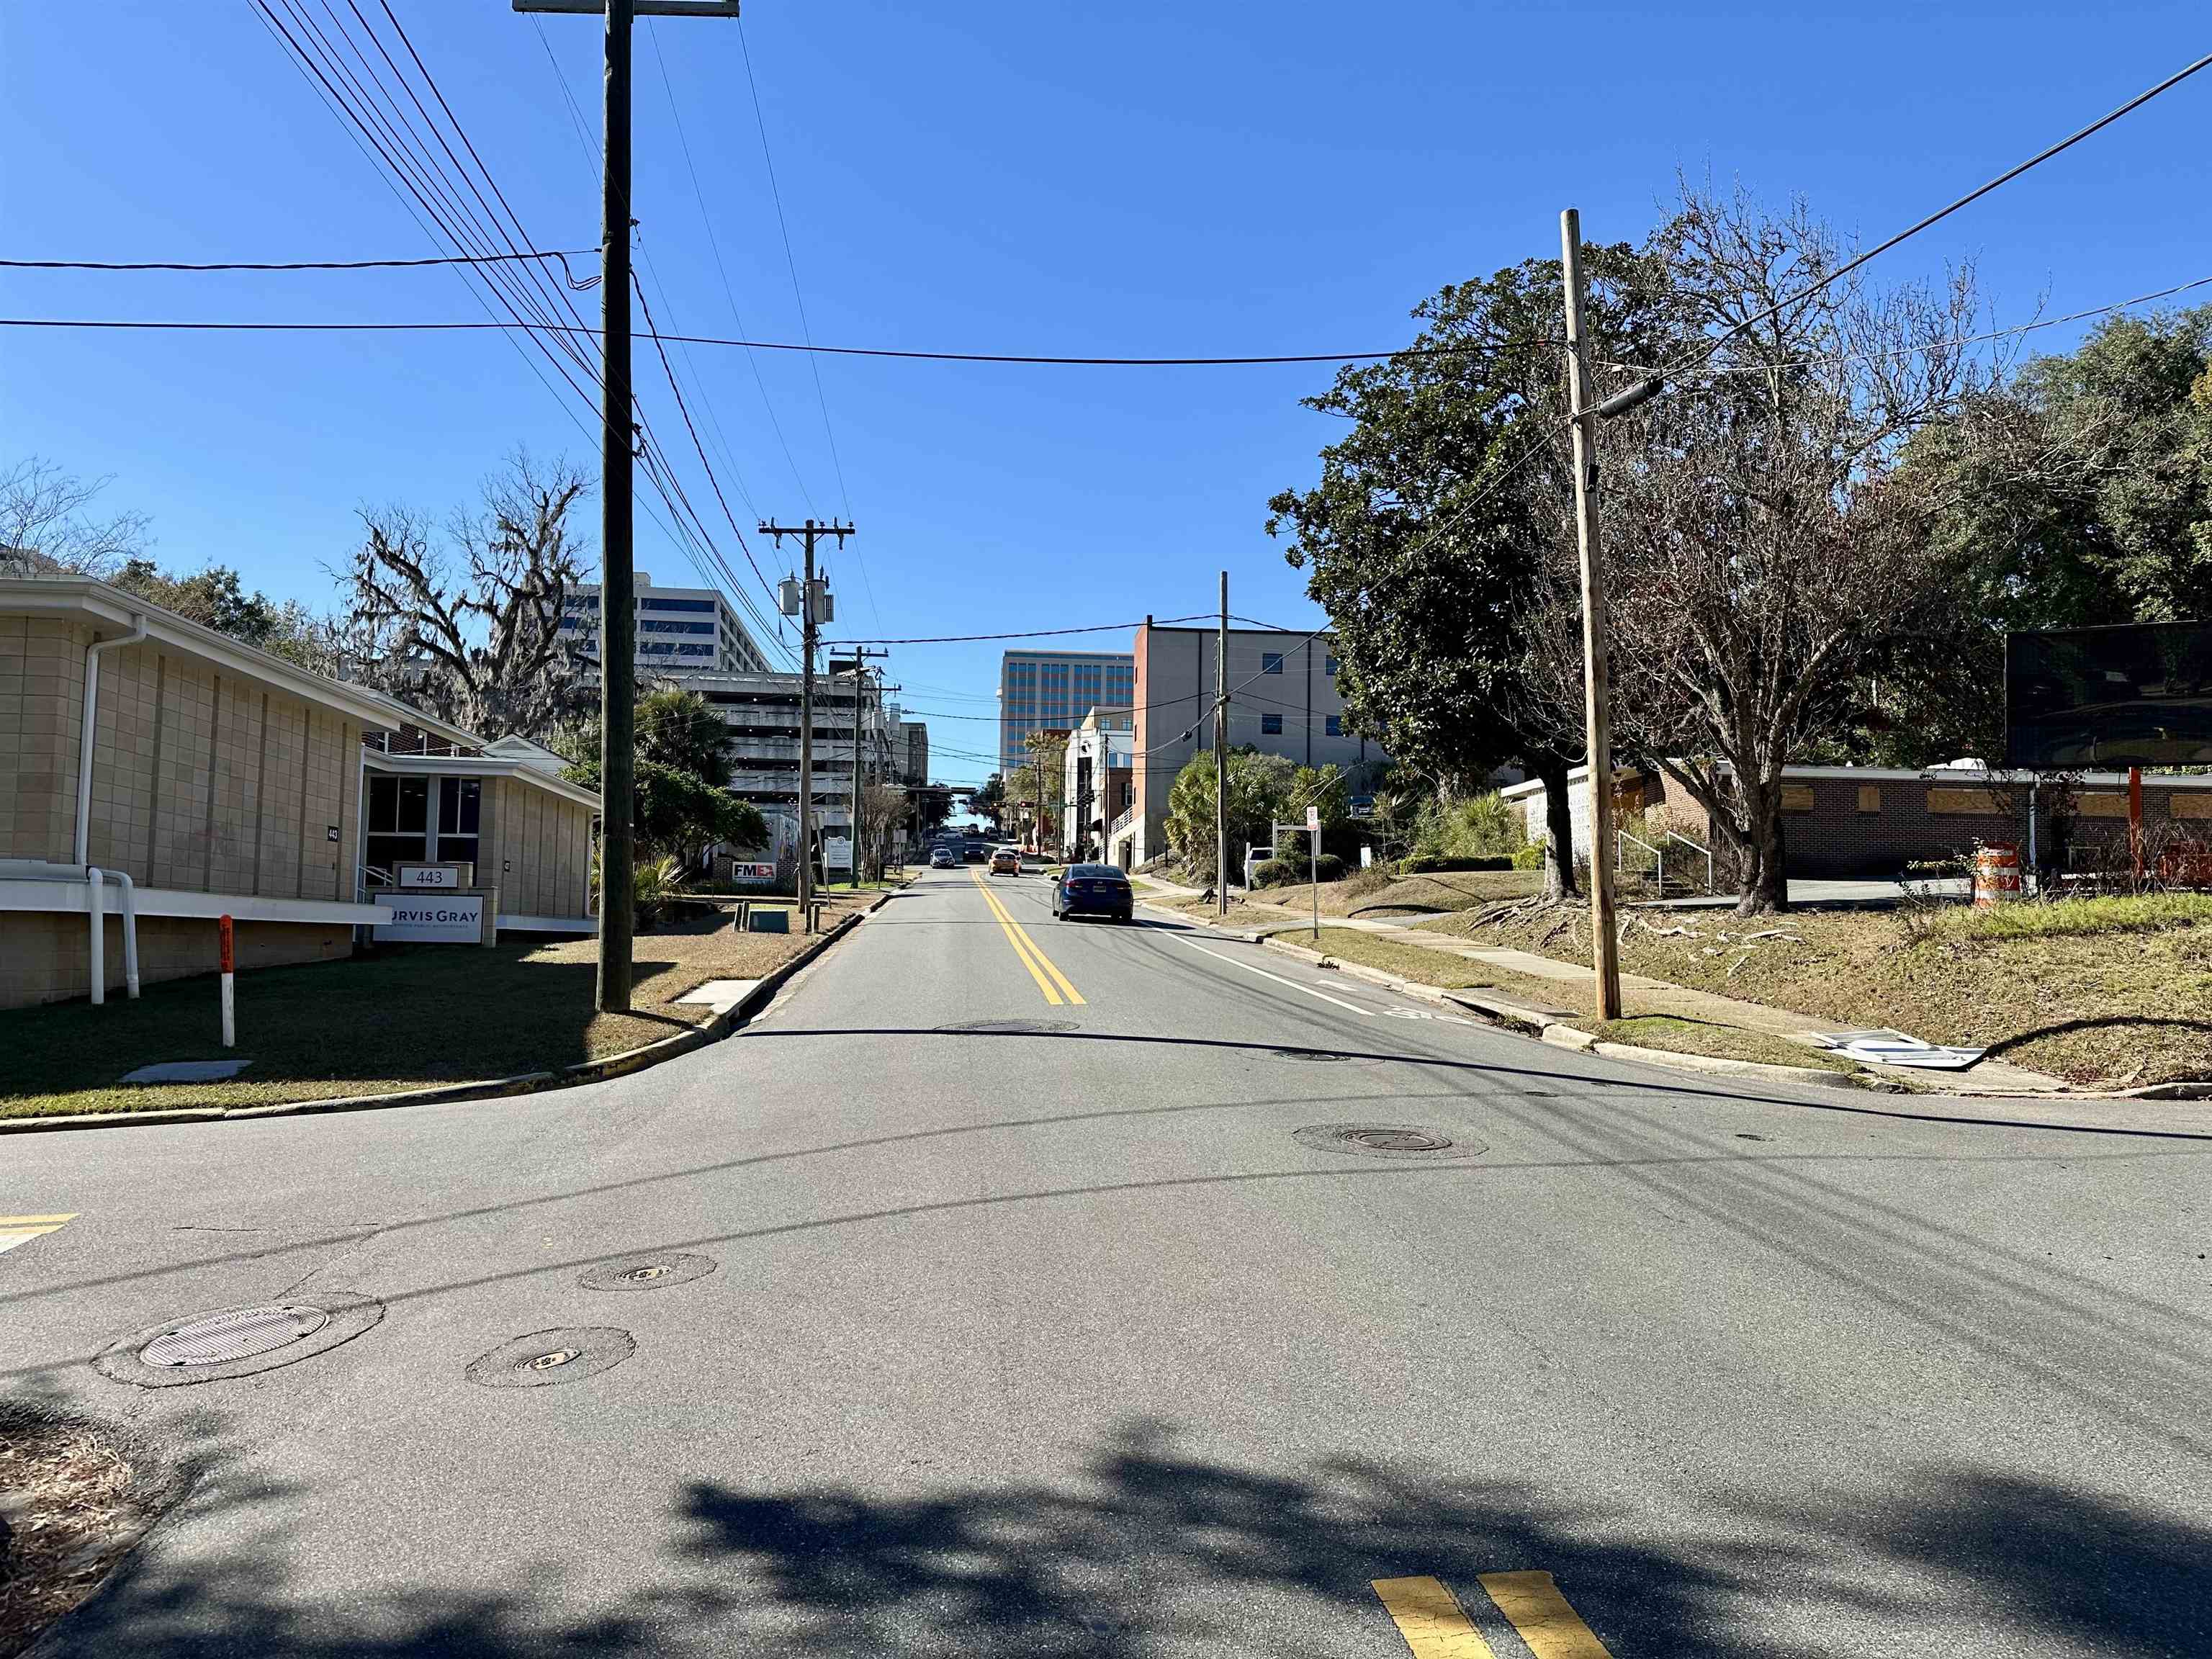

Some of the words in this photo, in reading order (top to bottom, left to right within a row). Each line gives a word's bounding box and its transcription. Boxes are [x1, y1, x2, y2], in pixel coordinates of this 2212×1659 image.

[329, 829, 338, 840] 443
[416, 871, 443, 884] 443
[436, 911, 478, 922] GRAY
